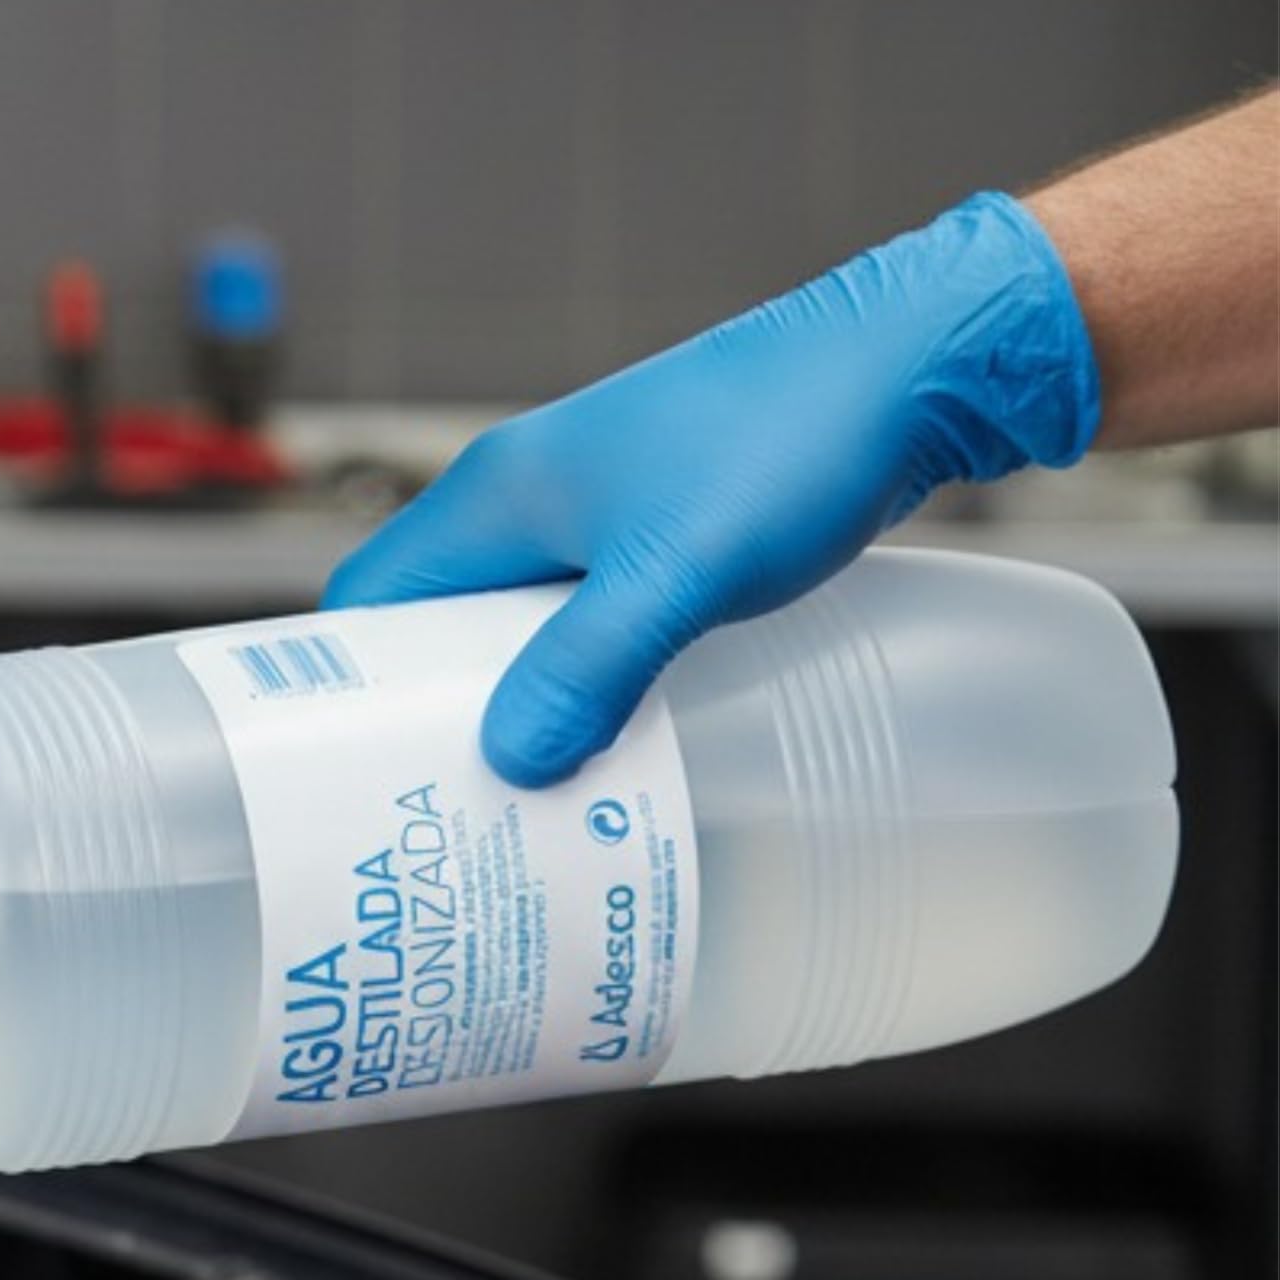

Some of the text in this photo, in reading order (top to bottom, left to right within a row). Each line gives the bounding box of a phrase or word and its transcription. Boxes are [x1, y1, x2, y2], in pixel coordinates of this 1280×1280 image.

[277, 942, 349, 1103] AGUA
[347, 848, 405, 1099] DESTILADA
[594, 884, 636, 1028] Adesco
